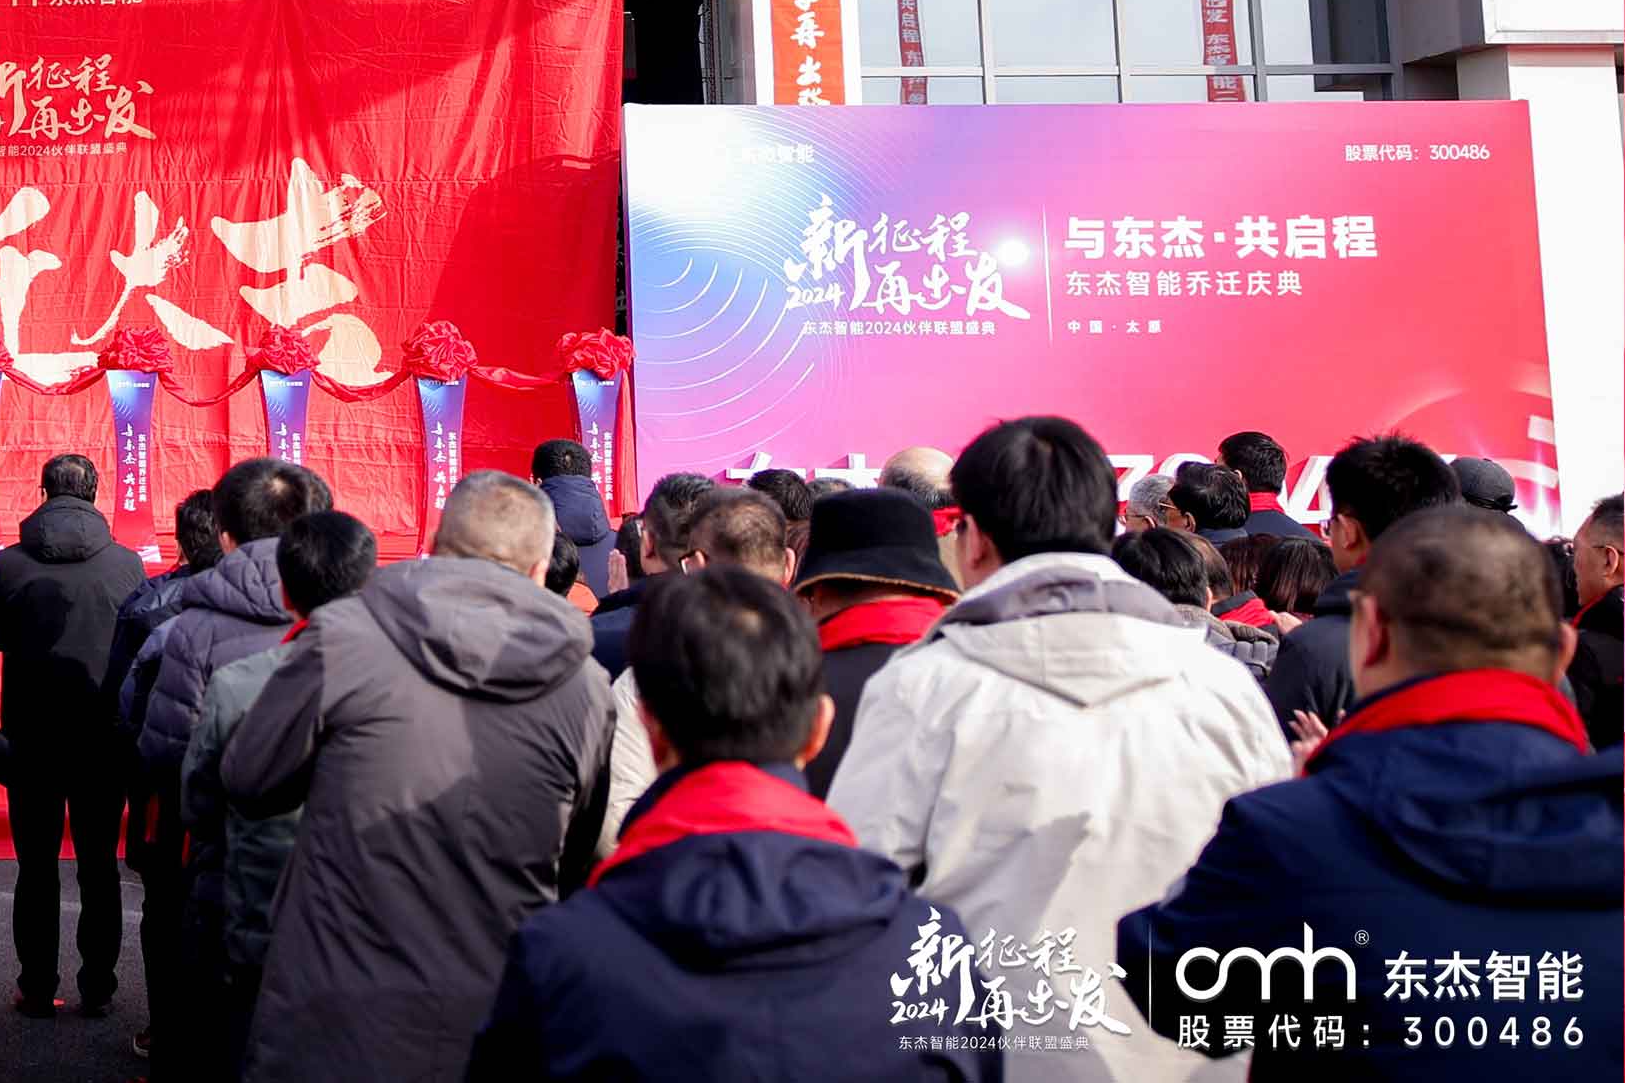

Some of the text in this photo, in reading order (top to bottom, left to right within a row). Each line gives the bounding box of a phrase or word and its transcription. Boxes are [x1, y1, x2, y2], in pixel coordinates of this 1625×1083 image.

[786, 282, 846, 311] 2024
[1065, 269, 1303, 297] 东杰智能乔迁庆典
[803, 320, 997, 336] 东杰智能2024伙伴联盟盛典
